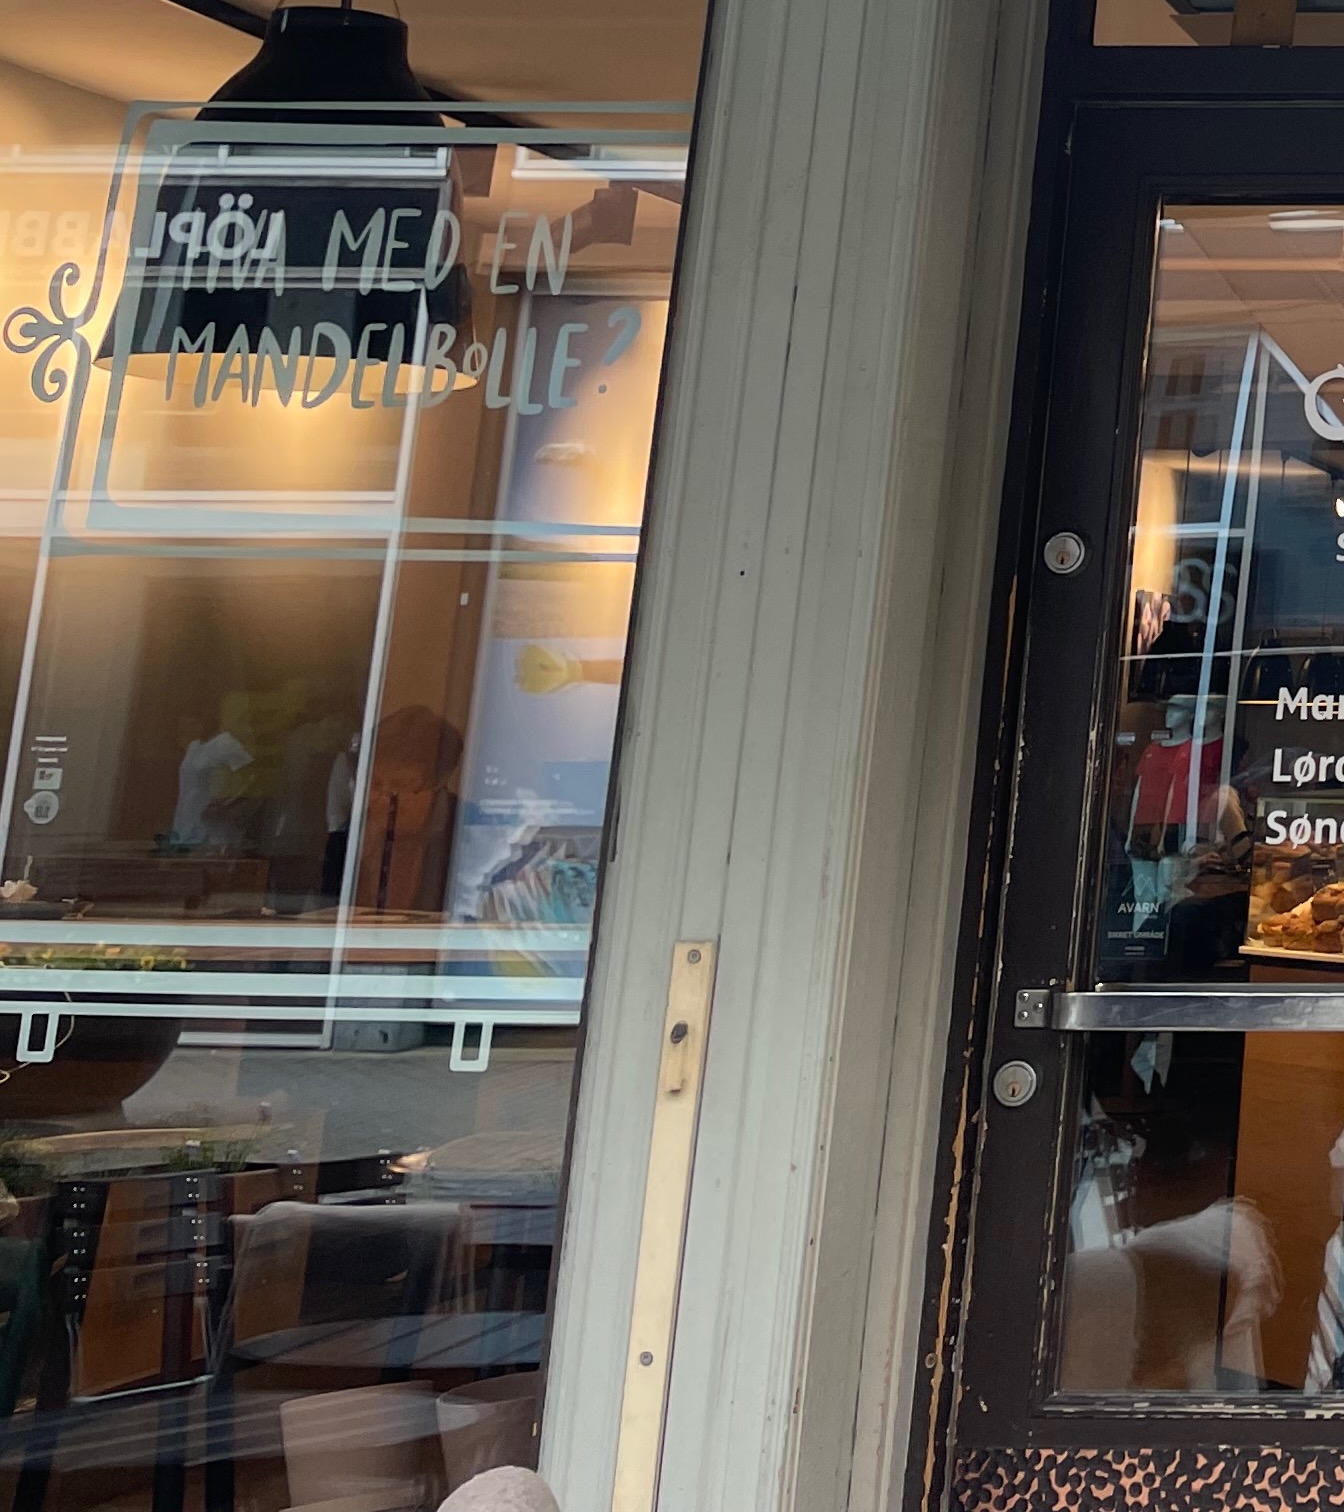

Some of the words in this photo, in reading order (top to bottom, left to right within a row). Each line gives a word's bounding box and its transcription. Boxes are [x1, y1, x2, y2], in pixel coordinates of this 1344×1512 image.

[322, 206, 462, 297] MED
[490, 211, 573, 296] EN
[1117, 902, 1160, 914] AVARN
